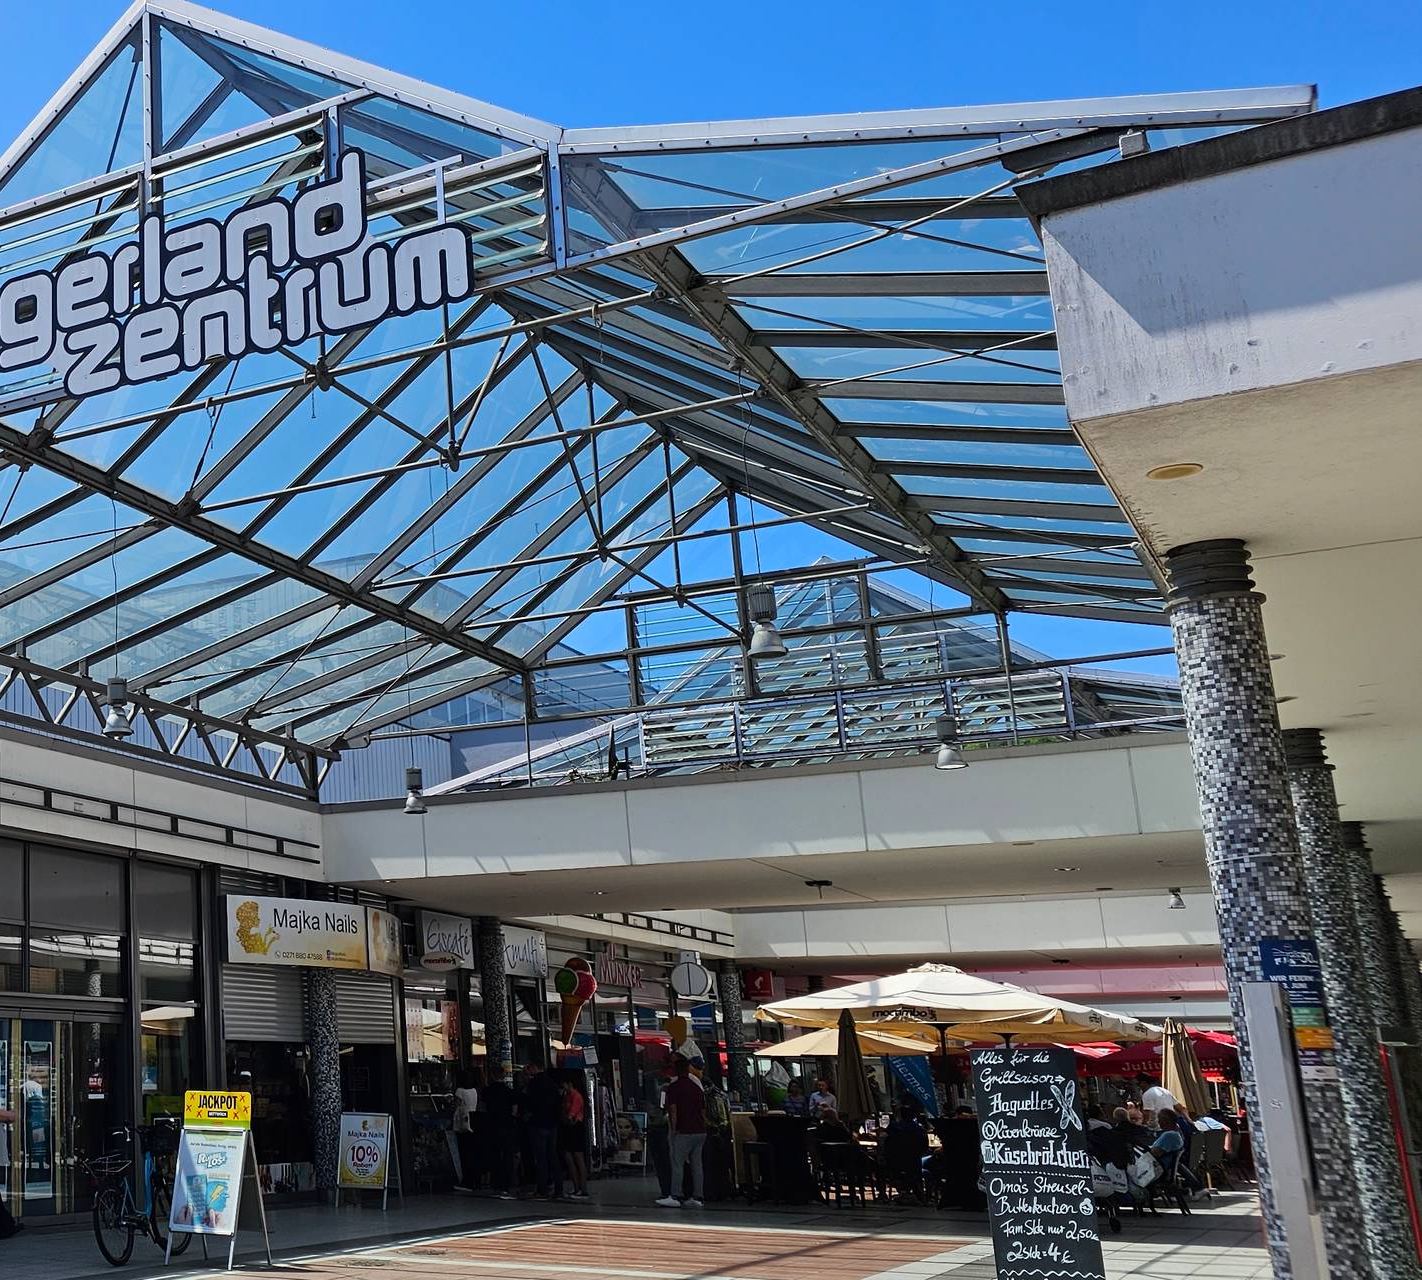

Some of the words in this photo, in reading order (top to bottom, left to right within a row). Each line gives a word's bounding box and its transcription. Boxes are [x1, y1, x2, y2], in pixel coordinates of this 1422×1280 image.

[63, 222, 476, 399] zentrum
[273, 908, 321, 934] Majka
[325, 912, 358, 934] Nails
[973, 1051, 1005, 1065] Alles
[1010, 1050, 1030, 1067] für
[1033, 1050, 1050, 1063] die
[1121, 1060, 1162, 1072] Juliu
[892, 1057, 931, 1101] Hermes
[979, 1068, 1055, 1092] Grillsaison
[198, 1094, 238, 1110] JACKPOT
[988, 1090, 1060, 1117] Baguettes,
[351, 1145, 378, 1163] 10%
[989, 1177, 1029, 1196] Oma's
[994, 1196, 1078, 1216] Butterkuchen
[1047, 1225, 1065, 1235] nur
